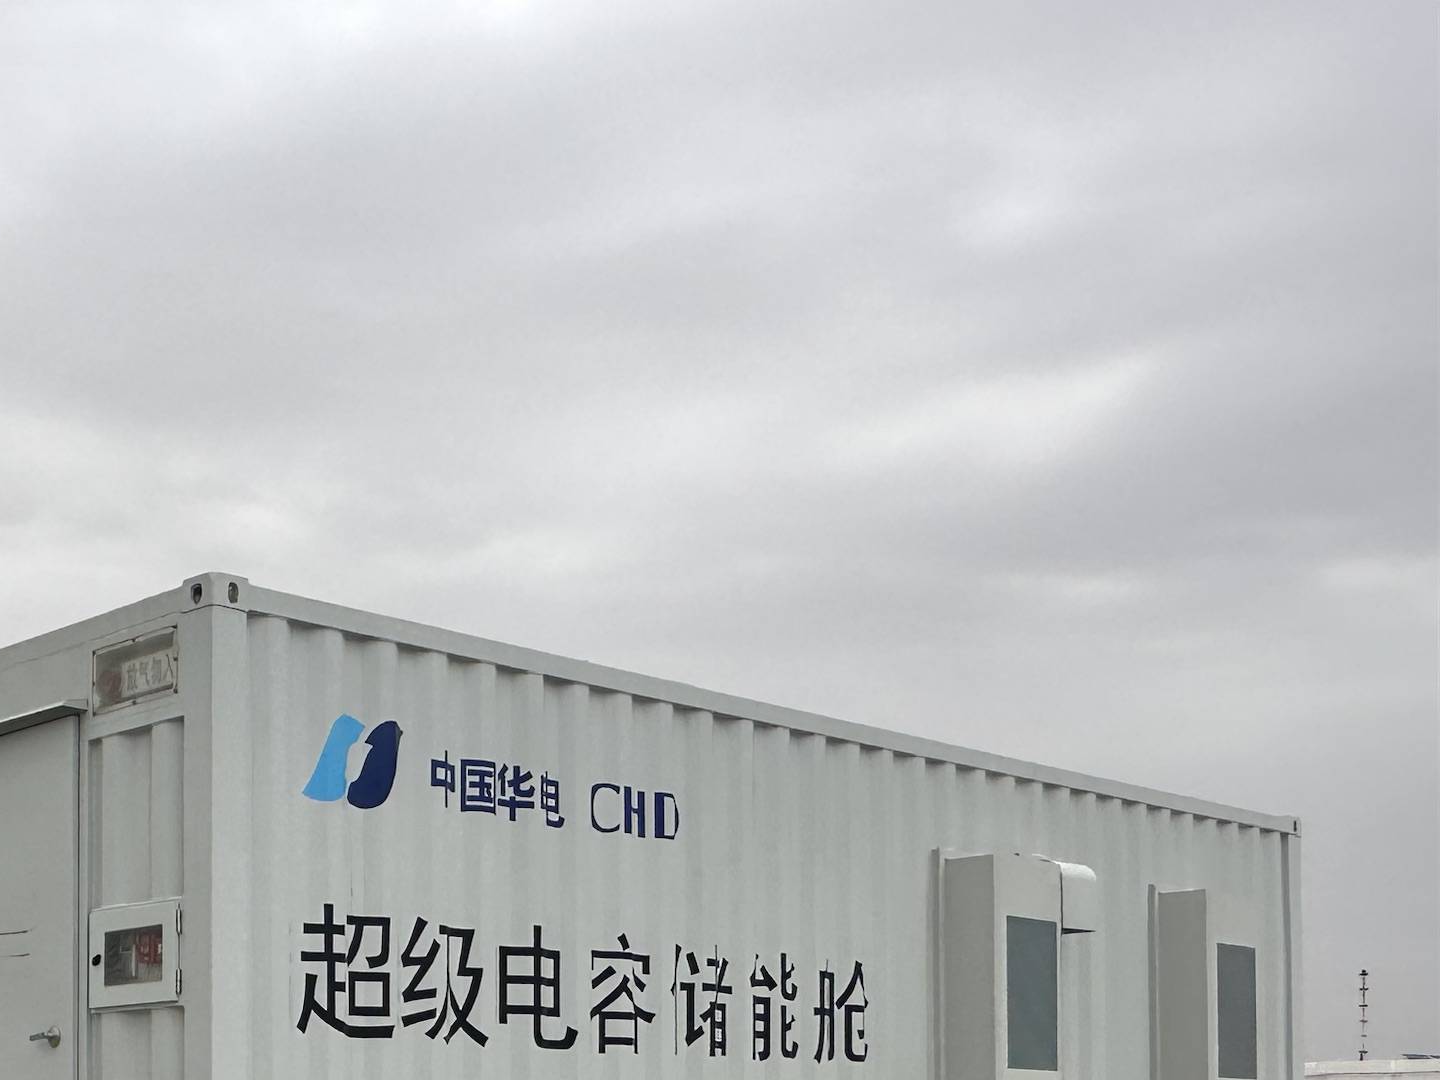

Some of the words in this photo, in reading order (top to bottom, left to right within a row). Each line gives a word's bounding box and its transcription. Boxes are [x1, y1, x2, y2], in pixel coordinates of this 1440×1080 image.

[430, 750, 565, 829] 中国华电
[590, 782, 680, 840] CHD
[296, 903, 870, 1064] 超级电容储能舱
